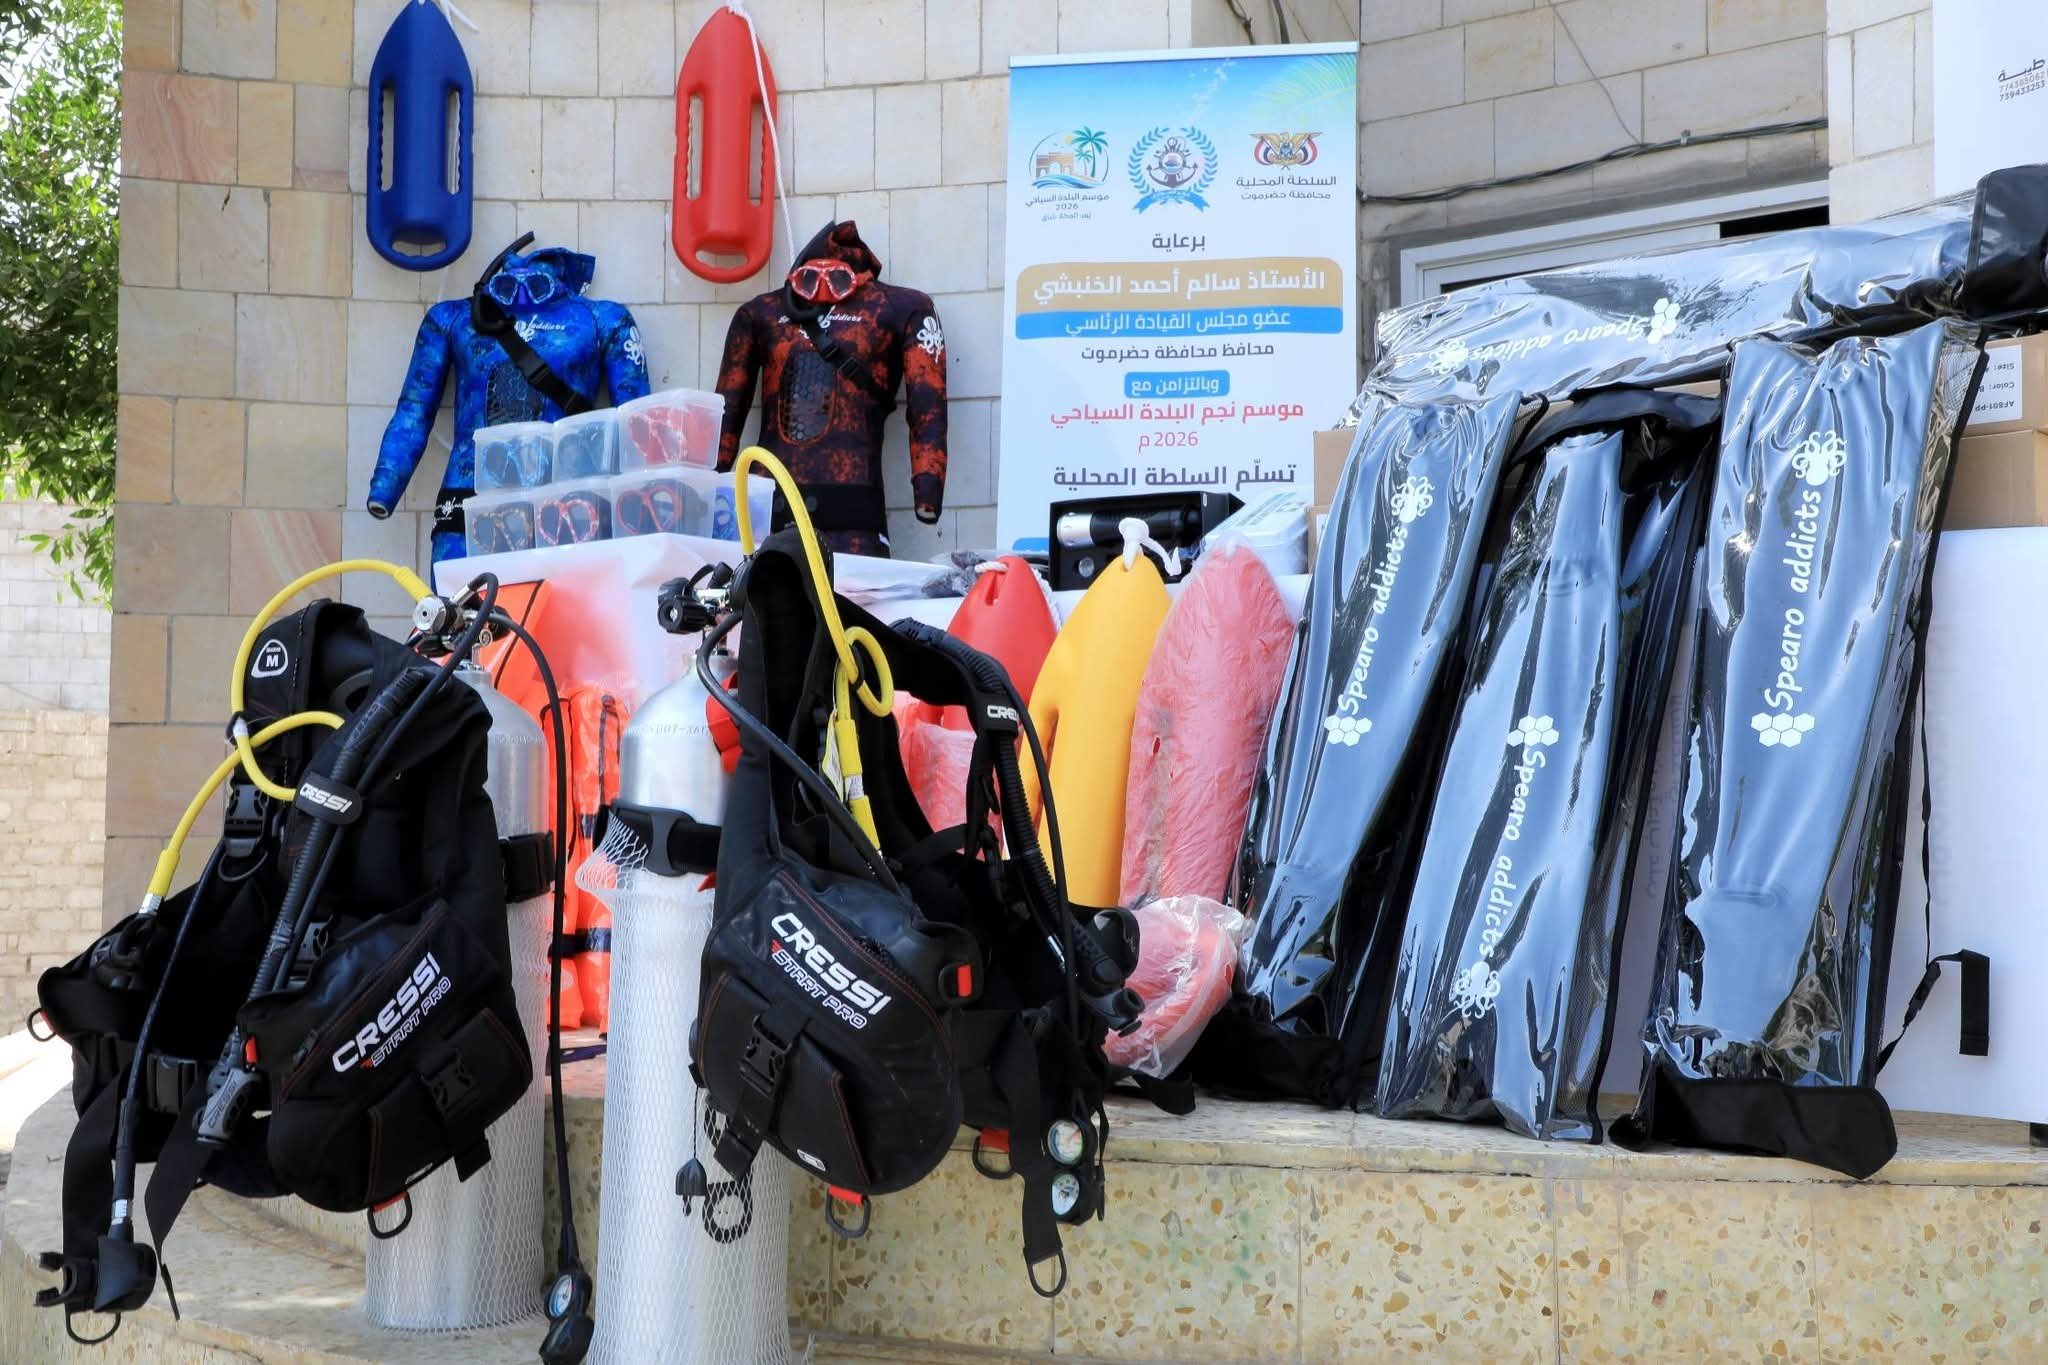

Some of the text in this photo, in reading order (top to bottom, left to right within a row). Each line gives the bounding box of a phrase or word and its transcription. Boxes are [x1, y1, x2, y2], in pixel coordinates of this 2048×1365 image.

[1236, 174, 1336, 190] السلطة المحلية
[1241, 190, 1331, 200] محافظة حضرموت
[1152, 233, 1205, 252] برعاية
[1034, 267, 1324, 304] الأستاذ سالم أحمد الخنبشي
[1066, 311, 1291, 336] عضو مجلس القيادة الرئاسي
[1468, 314, 1650, 361] Spearo addicts
[1081, 342, 1274, 362] محافظ محافظة حضرموت
[1131, 376, 1219, 396] وبالتزامن مع
[1988, 382, 2014, 391] Color:
[1050, 400, 1304, 429] موسم نجم البلدة السياحي
[1053, 466, 1136, 491] المحلية
[1145, 464, 1226, 486] السلطة
[1764, 489, 1822, 712] Spearo addicts
[1337, 526, 1408, 715] Spearo addicts
[266, 654, 278, 667] M
[987, 704, 1017, 720] CRE
[1478, 749, 1546, 959] Spearo addicts
[771, 912, 892, 1016] CRESSI
[772, 949, 868, 1030] START PRO
[332, 952, 441, 1072] CRESSI
[372, 976, 451, 1068] START PRO
